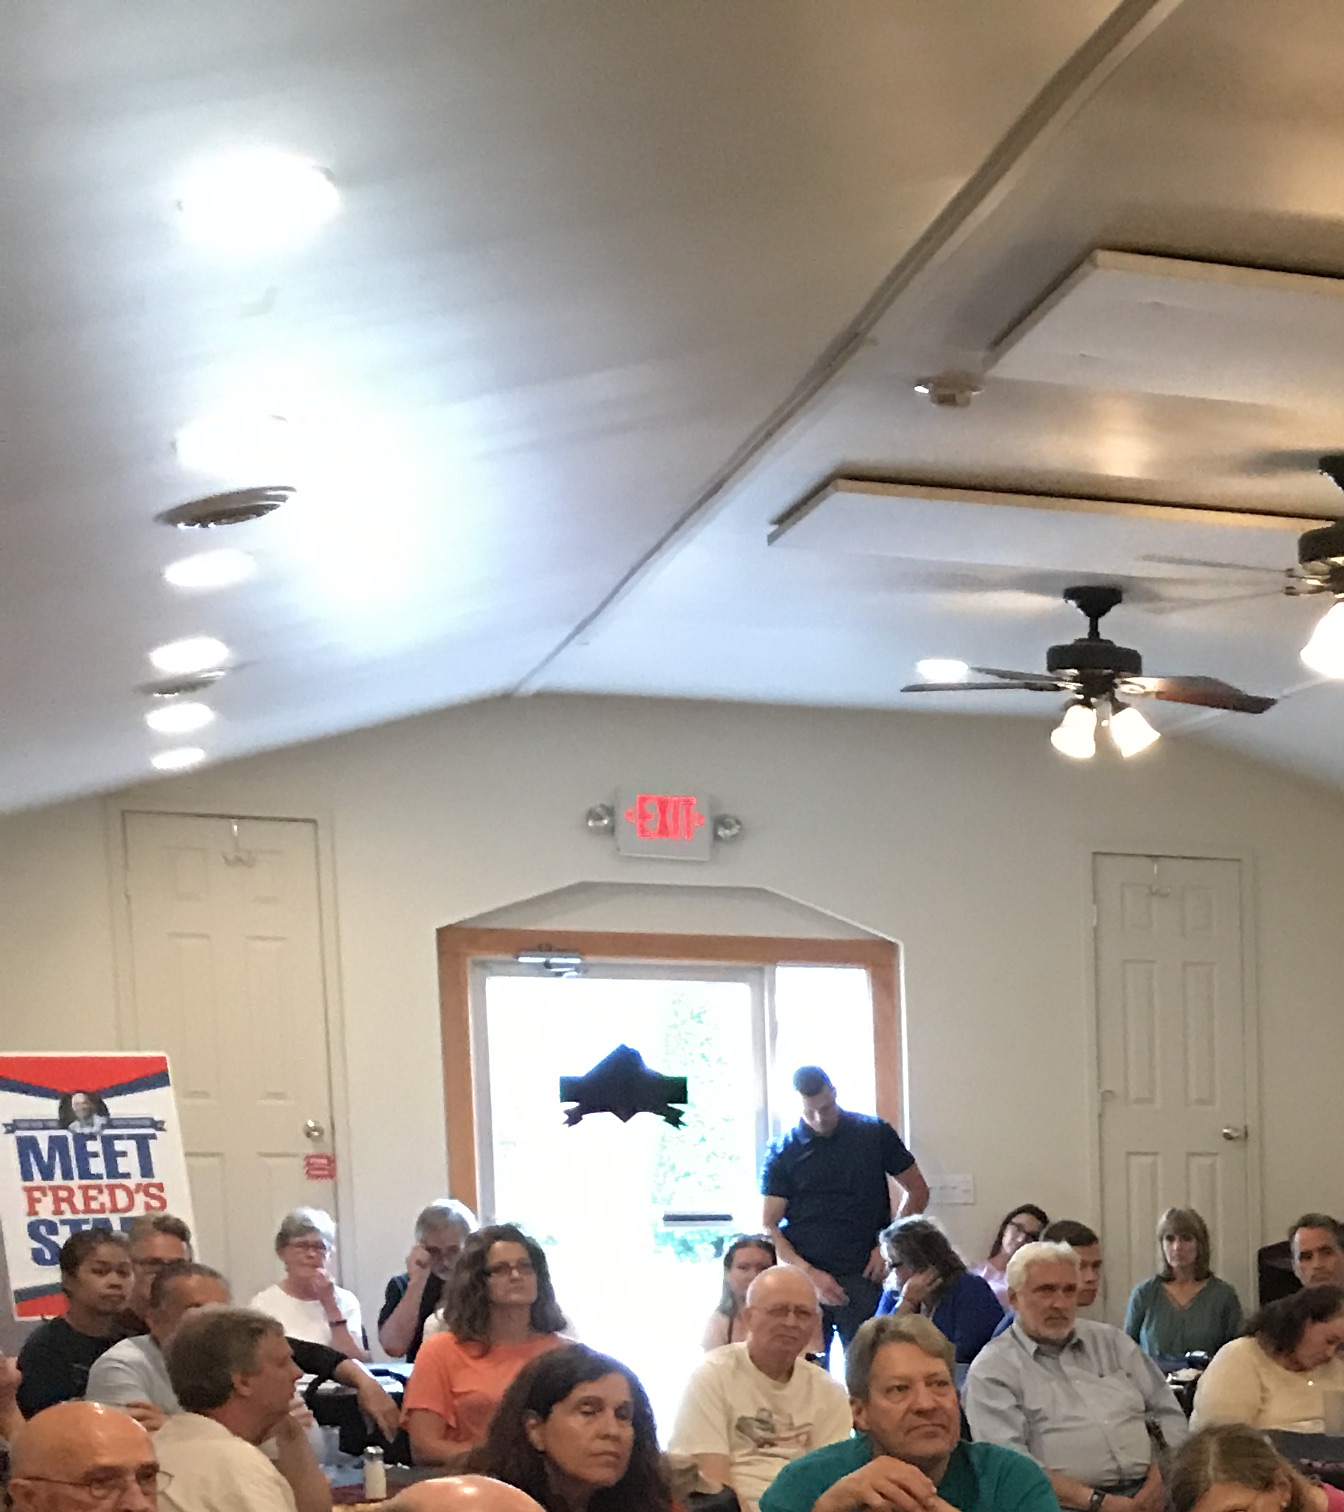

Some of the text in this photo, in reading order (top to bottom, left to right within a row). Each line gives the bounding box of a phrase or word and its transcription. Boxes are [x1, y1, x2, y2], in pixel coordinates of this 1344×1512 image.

[637, 794, 697, 840] EXIT
[16, 1133, 158, 1181] MEET
[22, 1182, 168, 1217] FRED'S
